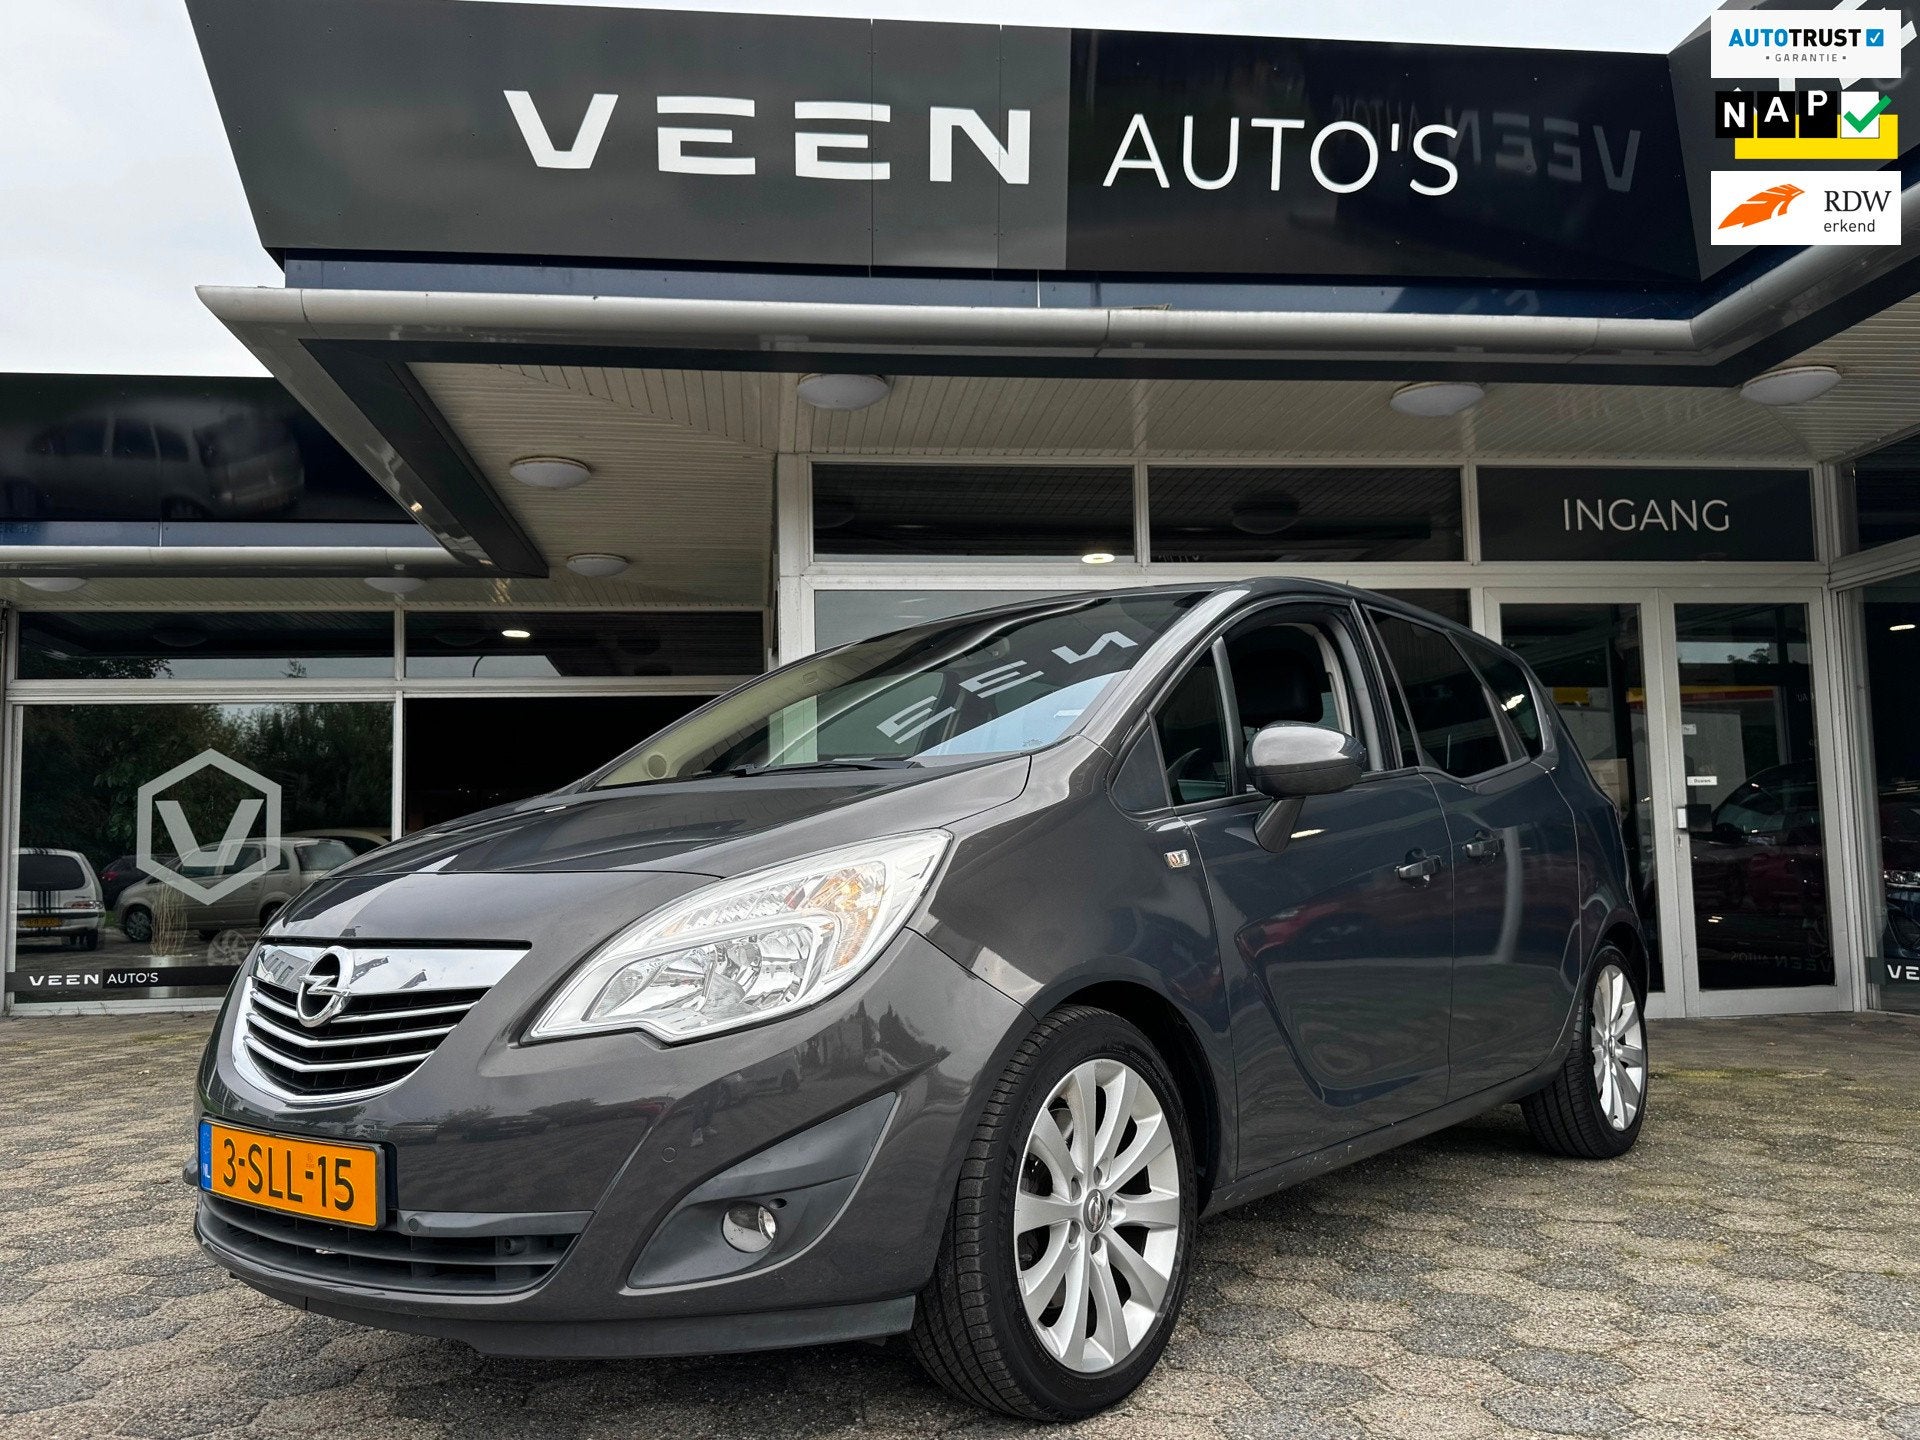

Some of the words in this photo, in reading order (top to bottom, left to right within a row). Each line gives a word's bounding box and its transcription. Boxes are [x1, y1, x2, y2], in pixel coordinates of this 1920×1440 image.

[503, 90, 1031, 185] VEEN
[1102, 113, 1458, 196] AUTO'S
[1563, 498, 1730, 533] INGANG
[29, 974, 99, 987] VEEN
[106, 972, 159, 984] AUTO'S
[223, 1137, 355, 1212] 3-SLL-15
